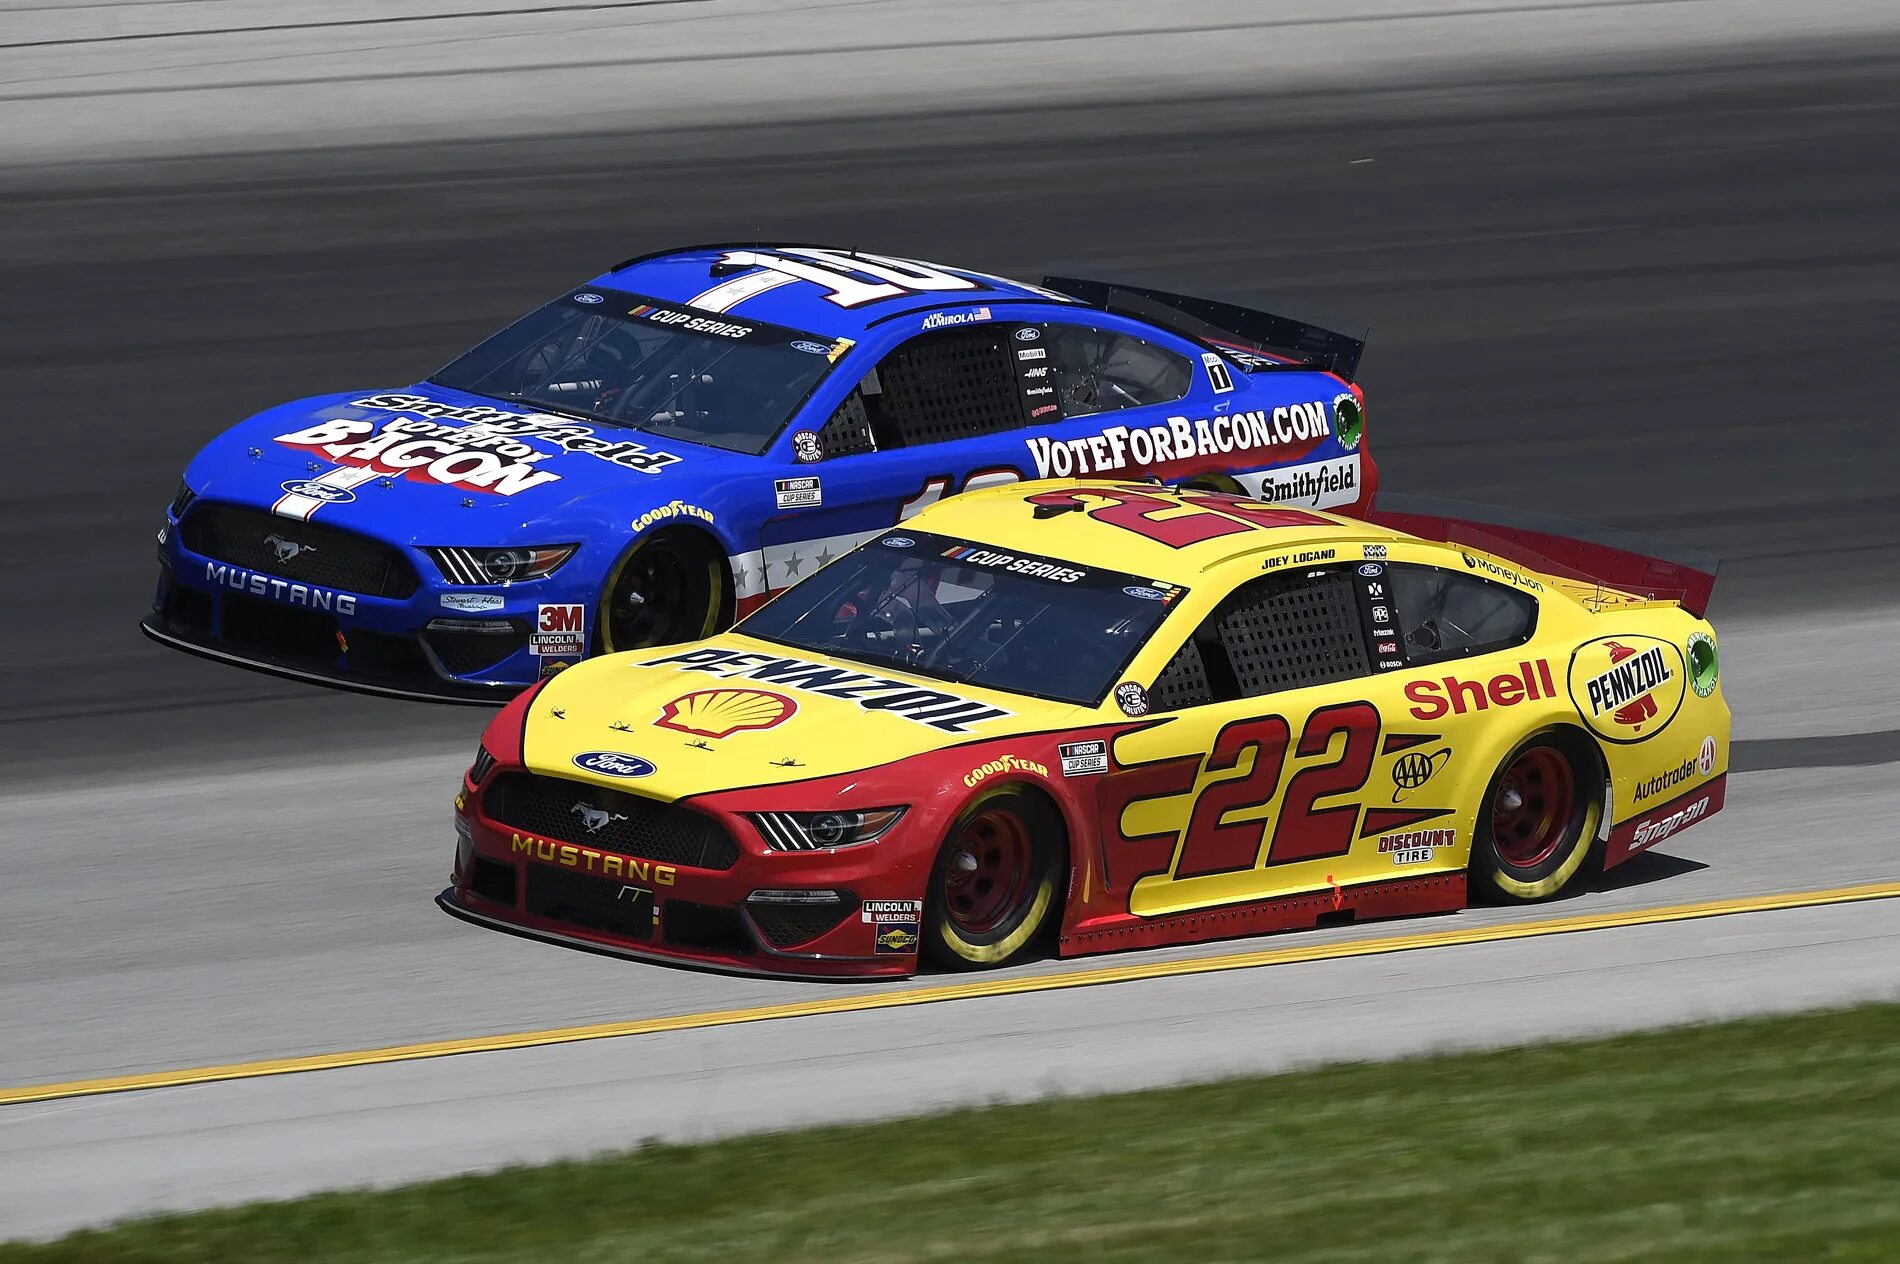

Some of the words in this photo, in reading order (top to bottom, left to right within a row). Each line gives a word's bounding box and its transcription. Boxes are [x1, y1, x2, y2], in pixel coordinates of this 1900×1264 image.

[717, 248, 980, 308] 10
[650, 309, 689, 326] CUP
[684, 318, 753, 339] SERIES
[921, 312, 974, 330] ALMIROLA
[1213, 366, 1226, 388] 1
[352, 395, 682, 472] Smithfield
[384, 416, 478, 446] VOTE
[794, 432, 817, 446] NASCAR
[273, 418, 562, 496] BACON
[798, 449, 821, 461] SALUTES
[286, 480, 350, 501] Ford
[782, 492, 795, 502] CUP
[795, 491, 815, 501] SERIES
[788, 480, 814, 490] NASCAR
[1261, 464, 1355, 506] Smithfield
[631, 500, 715, 533] GOODYEAR
[966, 550, 1011, 568] CUP
[1006, 557, 1087, 583] SERIES
[1261, 555, 1289, 570] JOEY
[1293, 548, 1336, 564] LOGANO
[1360, 564, 1381, 576] Ford
[1477, 558, 1545, 592] MoneyLion
[206, 562, 357, 616] MUSTANG
[539, 606, 583, 632] 3M
[532, 635, 575, 645] LINCOLN
[541, 645, 578, 653] WELDERS
[1687, 632, 1717, 655] AMERICAN
[638, 648, 1010, 732] PENNZOIL
[1118, 684, 1141, 697] NASCAR
[1404, 658, 1557, 721] Shell
[1587, 647, 1671, 716] PENNZOIL
[1692, 677, 1717, 697] ETHANOL
[1123, 702, 1147, 715] SALUTES
[1074, 743, 1099, 755] NASCAR
[580, 752, 647, 775] Ford
[963, 754, 1049, 788] GOODYEAR
[1068, 759, 1080, 769] CUP
[1080, 758, 1101, 769] SERIES
[1394, 753, 1431, 787] AAA
[1174, 700, 1381, 880] 22
[1633, 756, 1698, 804] Autotrader
[1377, 829, 1456, 853] DISCOUNT
[512, 833, 676, 886] MUSTANG
[1397, 849, 1431, 863] TIRE
[865, 902, 912, 913] LINCOLN
[875, 913, 916, 922] WELDERS
[879, 935, 916, 944] SUNOCO
